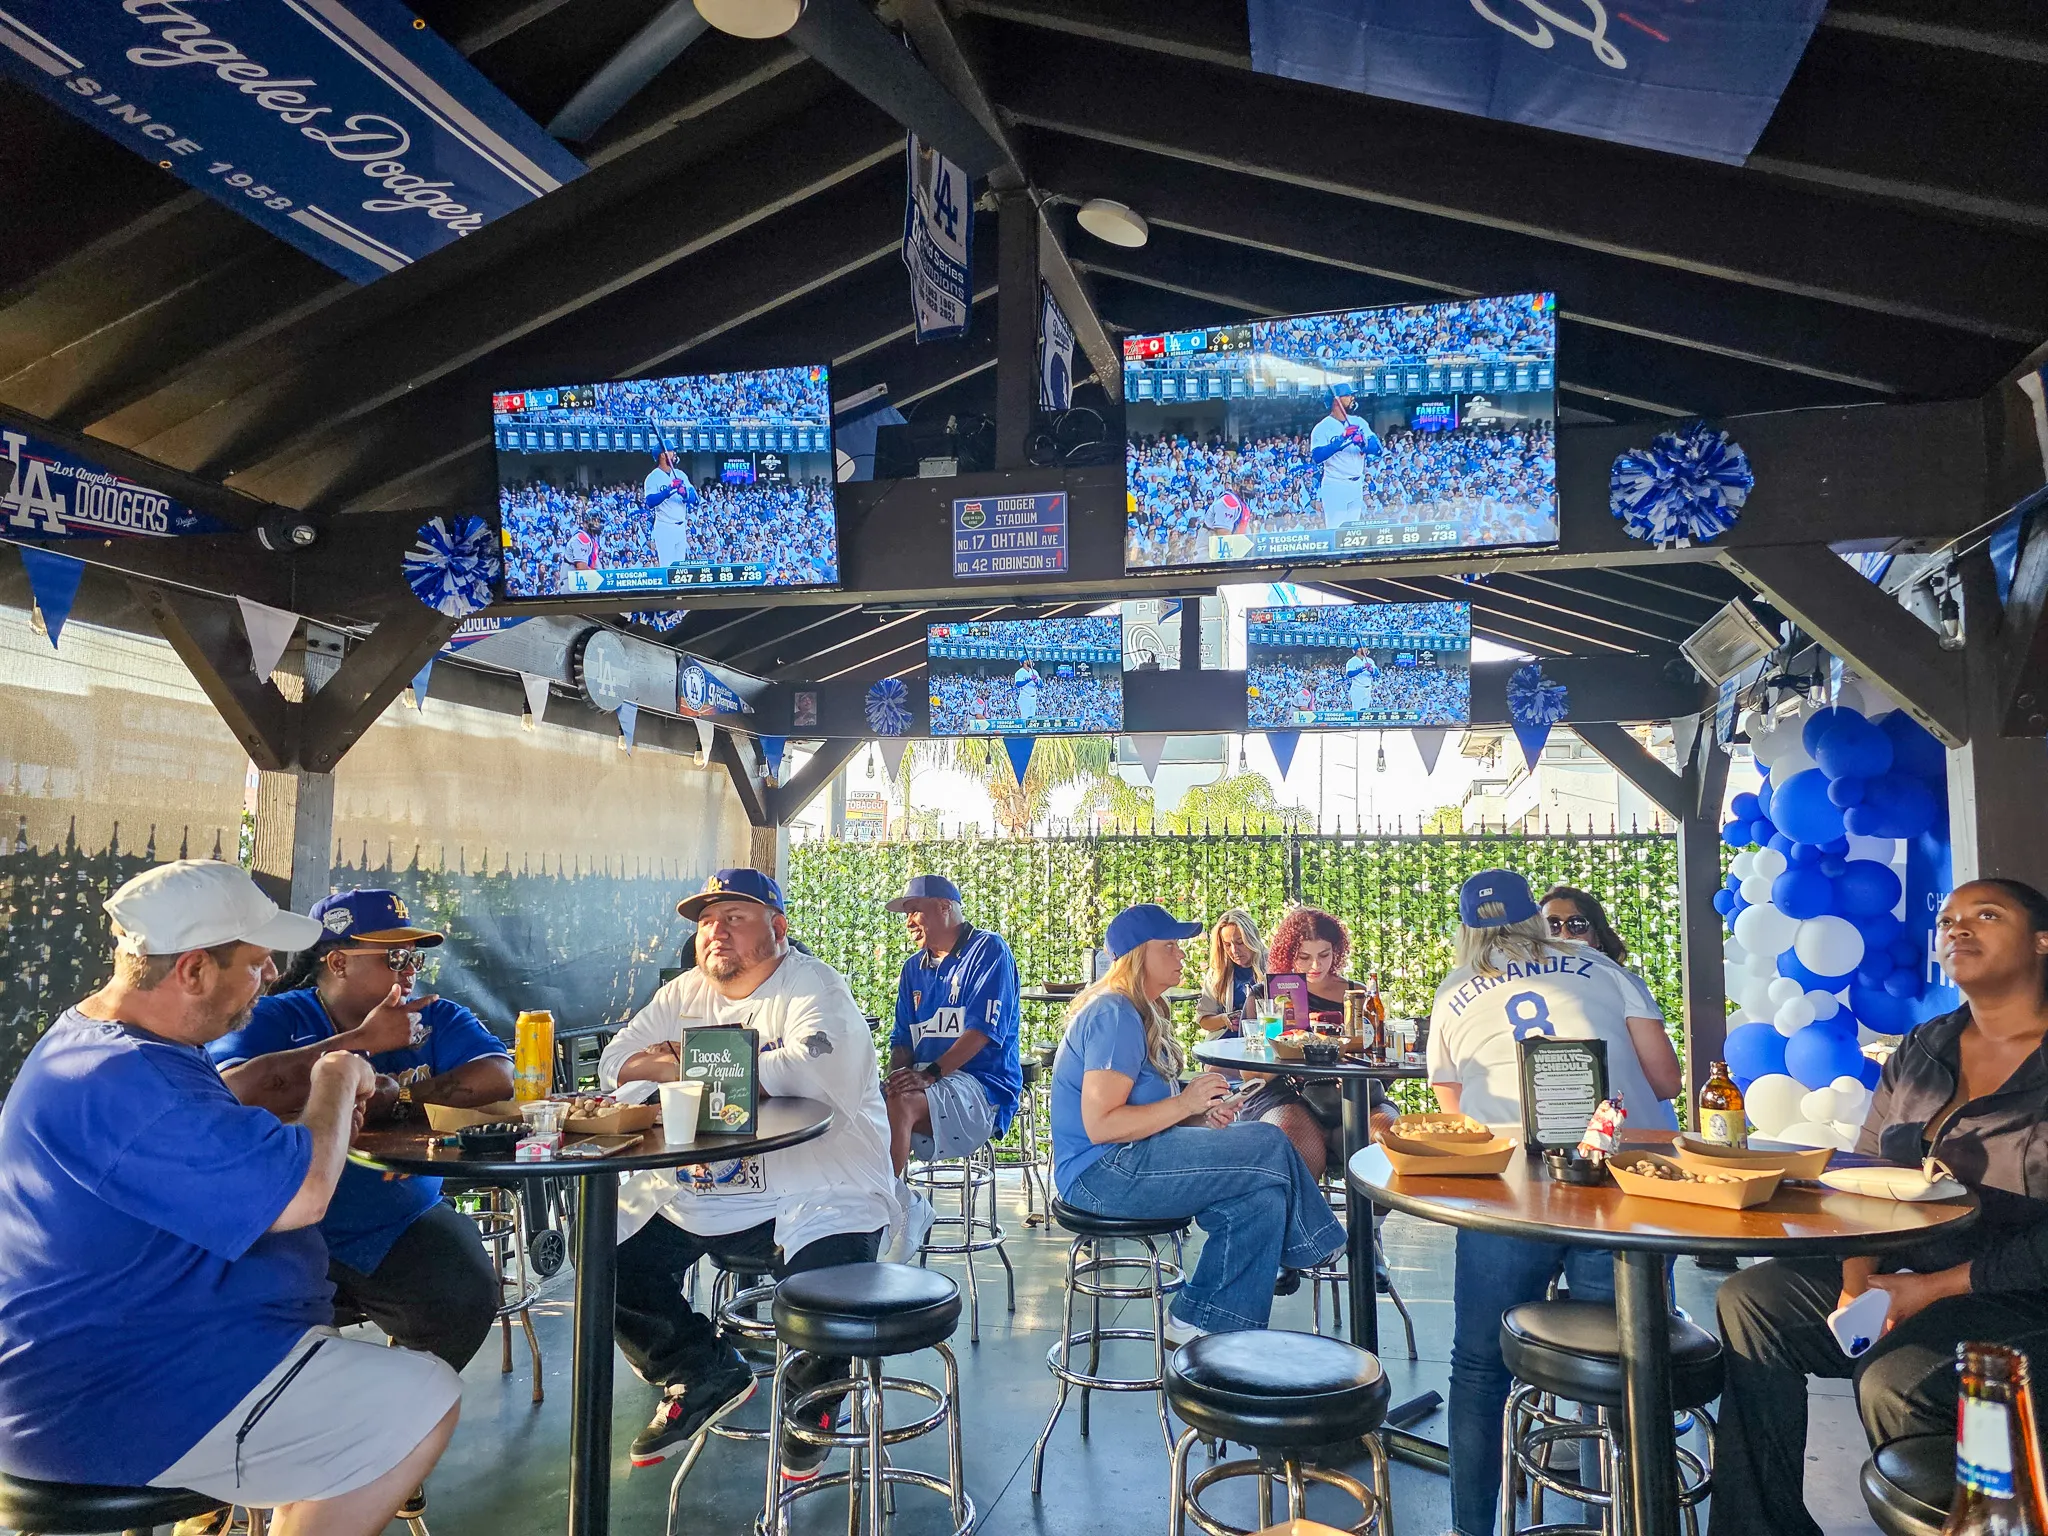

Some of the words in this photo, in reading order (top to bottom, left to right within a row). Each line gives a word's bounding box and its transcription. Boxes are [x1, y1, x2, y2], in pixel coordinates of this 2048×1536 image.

[123, 0, 332, 125] ngeles
[301, 114, 483, 238] Dodger
[64, 76, 203, 156] SINCE
[207, 161, 293, 211] 1958
[933, 250, 965, 284] Series
[1149, 340, 1159, 351] 0
[1190, 335, 1201, 347] 0
[512, 396, 521, 406] 0
[545, 393, 553, 404] 0
[1416, 406, 1451, 415] FANFEST
[1420, 414, 1448, 424] NIGHTS
[723, 462, 750, 470] FANFEST
[53, 461, 74, 478] Los
[75, 466, 119, 488] Angeles
[75, 480, 169, 532] DODGERS
[997, 498, 1035, 512] DODGER
[995, 512, 1038, 526] STADIUM
[991, 531, 1038, 549] OHTANI
[1041, 534, 1058, 546] AVE
[1269, 534, 1310, 544] TEOSCAR
[1340, 536, 1368, 548] .247
[1376, 534, 1394, 545] 25
[1402, 533, 1420, 544] 89
[1428, 530, 1457, 542] .738
[1346, 529, 1362, 537] AVG
[1379, 527, 1391, 535] HR
[1218, 536, 1233, 559] LA
[1269, 540, 1329, 553] HERNÁNDEZ
[991, 554, 1044, 571] ROBINSON
[1045, 557, 1057, 568] ST
[615, 571, 648, 579] TEOSCAR
[671, 574, 694, 584] .247
[700, 573, 714, 583] 25
[719, 572, 734, 582] 89
[740, 570, 762, 581] .738
[701, 567, 711, 575] HR
[575, 571, 588, 591] LA
[616, 577, 663, 587] HERNÁNDEZ
[596, 647, 617, 698] LA
[690, 676, 699, 701] LA
[388, 894, 411, 920] LA
[1448, 955, 1594, 1017] HERNÁNDEZ
[984, 998, 1003, 1027] 15
[1504, 990, 1557, 1042] 8
[689, 1048, 721, 1063] Tacos
[1533, 1053, 1576, 1063] WEEKLY
[707, 1062, 745, 1081] Tequila
[1534, 1062, 1589, 1072] SCHEDULE
[749, 1176, 761, 1189] K
